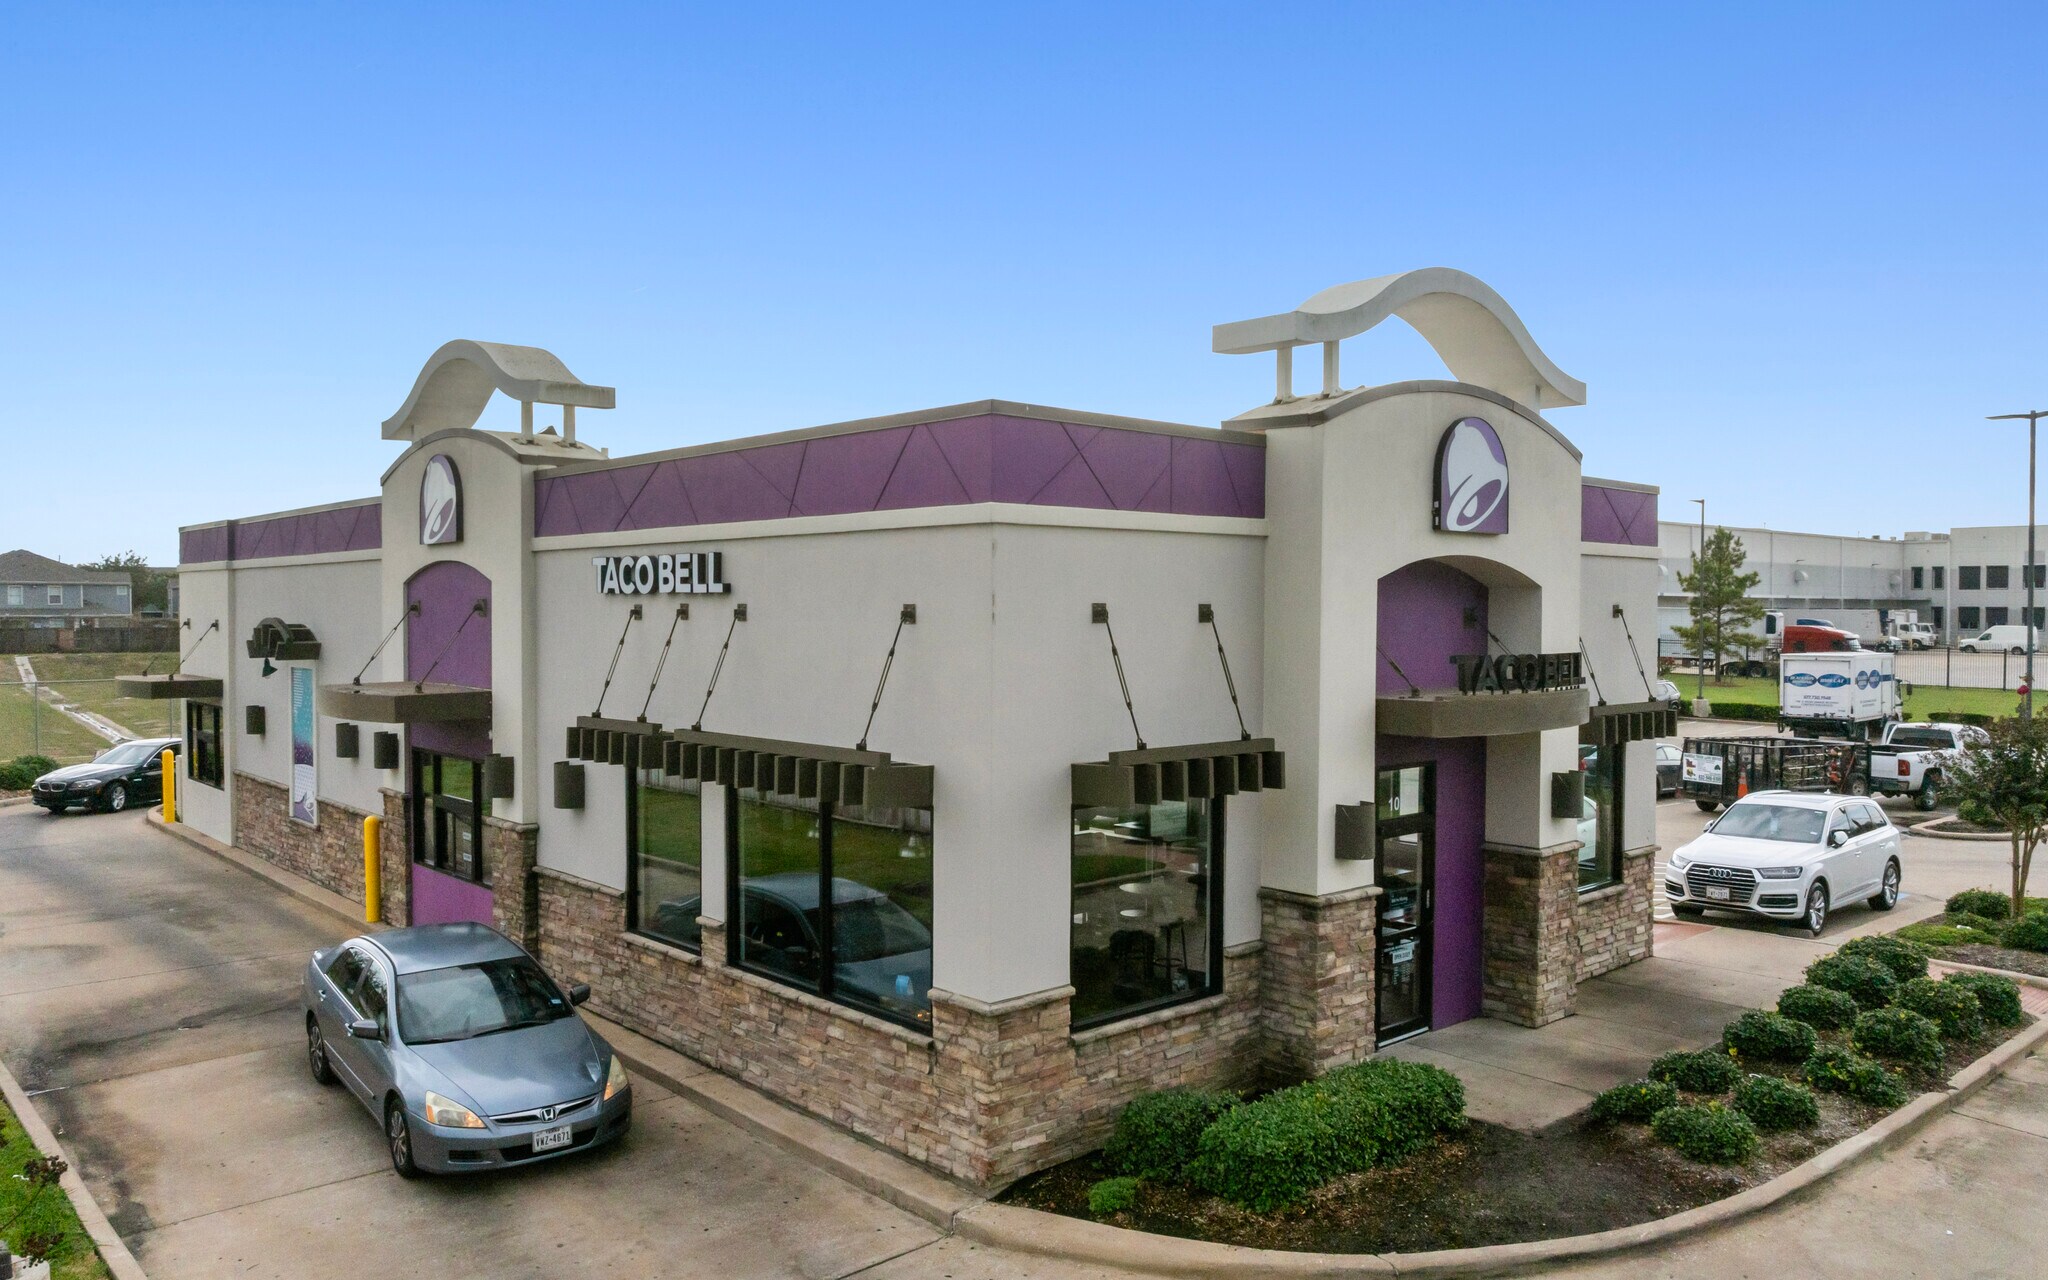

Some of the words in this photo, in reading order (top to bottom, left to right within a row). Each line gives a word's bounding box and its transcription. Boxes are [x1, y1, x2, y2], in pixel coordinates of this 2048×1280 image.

[592, 555, 655, 595] TACO
[658, 552, 726, 594] BELL
[1449, 653, 1539, 691] TACO
[1388, 796, 1400, 811] 10
